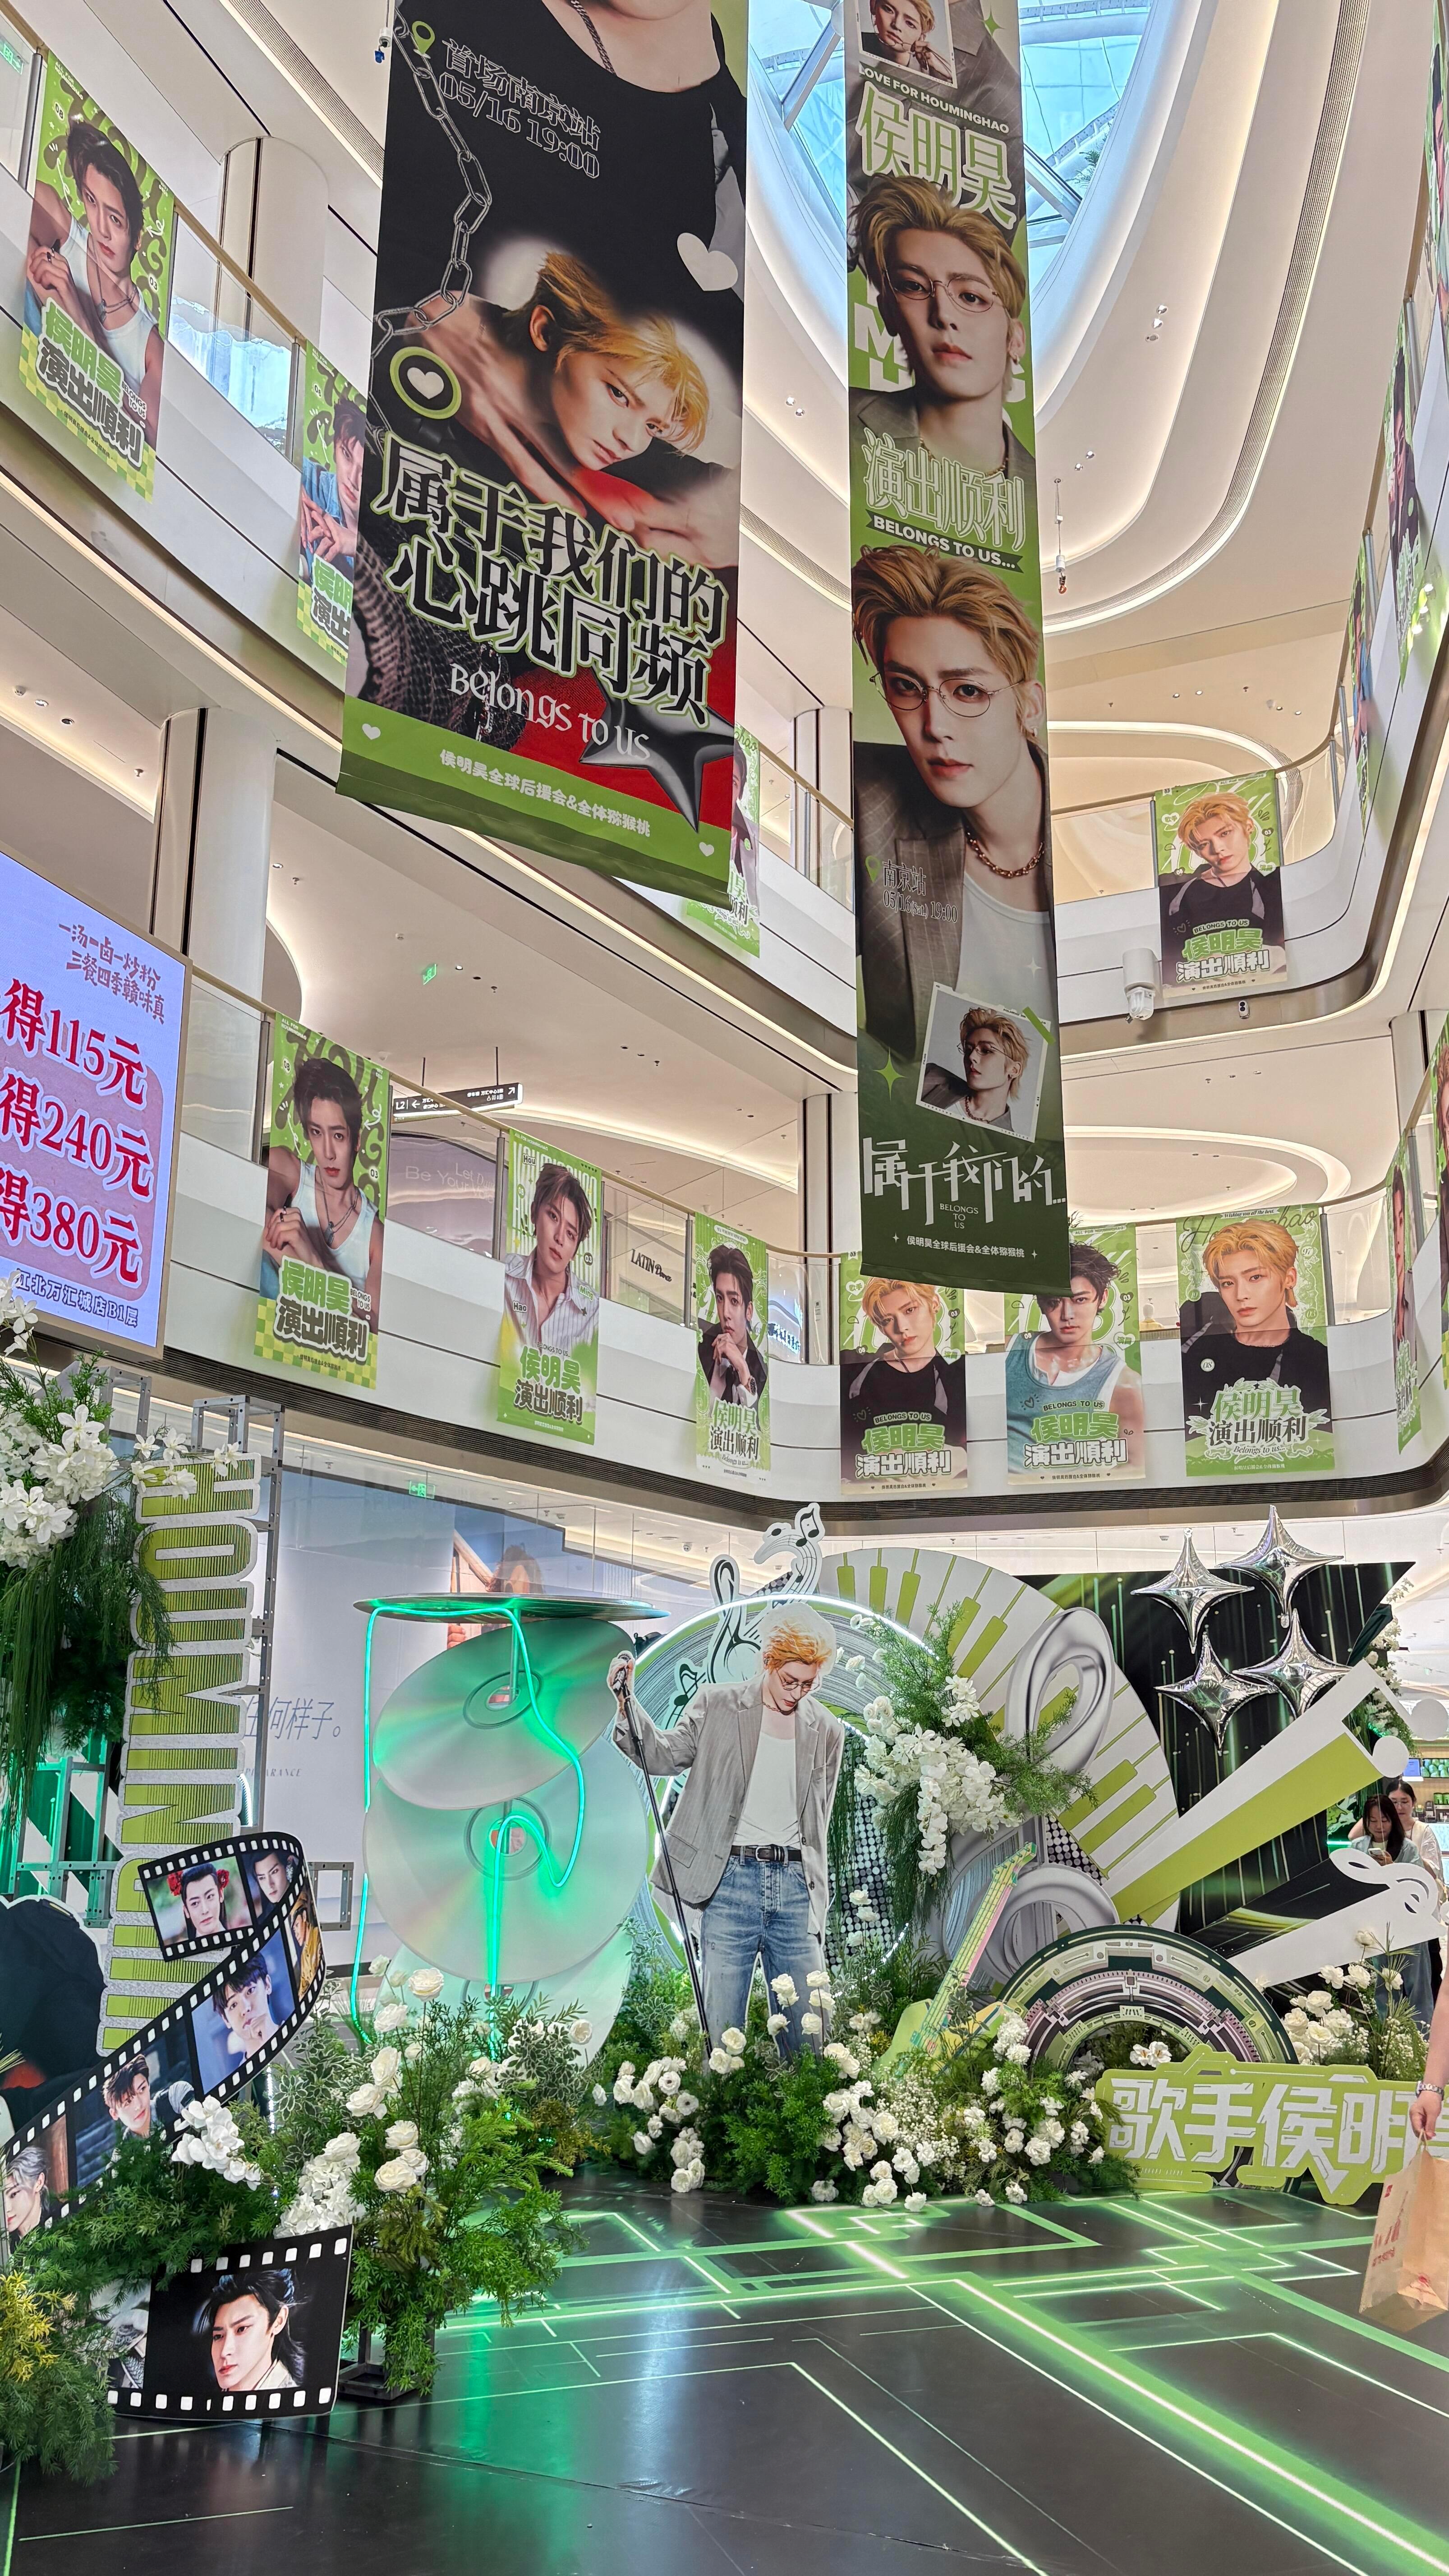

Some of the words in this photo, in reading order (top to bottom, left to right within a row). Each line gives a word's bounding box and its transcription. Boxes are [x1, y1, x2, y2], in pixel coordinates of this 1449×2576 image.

[442, 38, 601, 151] 首场南京站
[859, 62, 891, 87] LOVE
[893, 79, 919, 99] FOR
[920, 91, 1009, 134] HOUMINGHAO
[54, 103, 64, 119] 08
[439, 72, 521, 133] 05/16
[526, 120, 600, 178] 19:00
[856, 83, 1017, 228] 侯明昊
[149, 277, 158, 291] 03
[45, 301, 122, 405] 侯明昊
[121, 381, 146, 409] BELONGS
[129, 398, 137, 410] TO
[138, 405, 146, 418] US
[862, 427, 1026, 551] 演出顺利
[370, 432, 729, 647] 属于我们的
[873, 515, 950, 552] BELONGS
[953, 541, 974, 558] TO
[978, 550, 1015, 569] US...
[385, 532, 713, 728] 心跳同频
[615, 726, 652, 760] us
[439, 749, 651, 838] 侯明昊全球后援会&全体猕猴桃
[883, 859, 926, 896] 南京站
[883, 889, 929, 920] 05/16(Sat.)
[930, 902, 958, 923] 19:00
[1194, 922, 1224, 933] BELONGS
[59, 923, 161, 991] 一汤一卤一炒粉
[1182, 929, 1263, 961] 侯明昊
[281, 1018, 290, 1026] ALL
[290, 1022, 299, 1030] FOR
[0, 978, 147, 1105] 得115元
[396, 1101, 405, 1110] L2
[0, 1073, 152, 1198] 得240元
[370, 1168, 378, 1179] 03
[405, 1165, 432, 1181] Be
[523, 1155, 536, 1165] Hou
[939, 1203, 979, 1214] BELONGS
[0, 1167, 139, 1283] 得380元
[630, 1248, 655, 1274] LATIN
[906, 1235, 1025, 1258] 侯明昊全球后援会&全体猕猴桃
[281, 1259, 350, 1316] 侯明昊
[350, 1288, 371, 1302] BELONGS
[580, 1286, 594, 1300] Ming
[357, 1300, 364, 1308] TO
[513, 1302, 527, 1312] Hao
[537, 1342, 555, 1353] BELONGS
[520, 1345, 581, 1394] 侯明昊
[1203, 1361, 1212, 1369] 08
[515, 1379, 583, 1422] 演出顺利
[1043, 1401, 1077, 1412] BELONGS
[1213, 1388, 1301, 1421] 侯明昊
[713, 1399, 758, 1437] 侯明昊
[875, 1412, 906, 1423] BELONGS
[1030, 1412, 1119, 1443] 侯明昊
[1209, 1415, 1307, 1446] 演出顺利
[710, 1425, 759, 1460] 演出顺利
[861, 1423, 945, 1454] 侯明昊
[1233, 1446, 1261, 1455] Belongs
